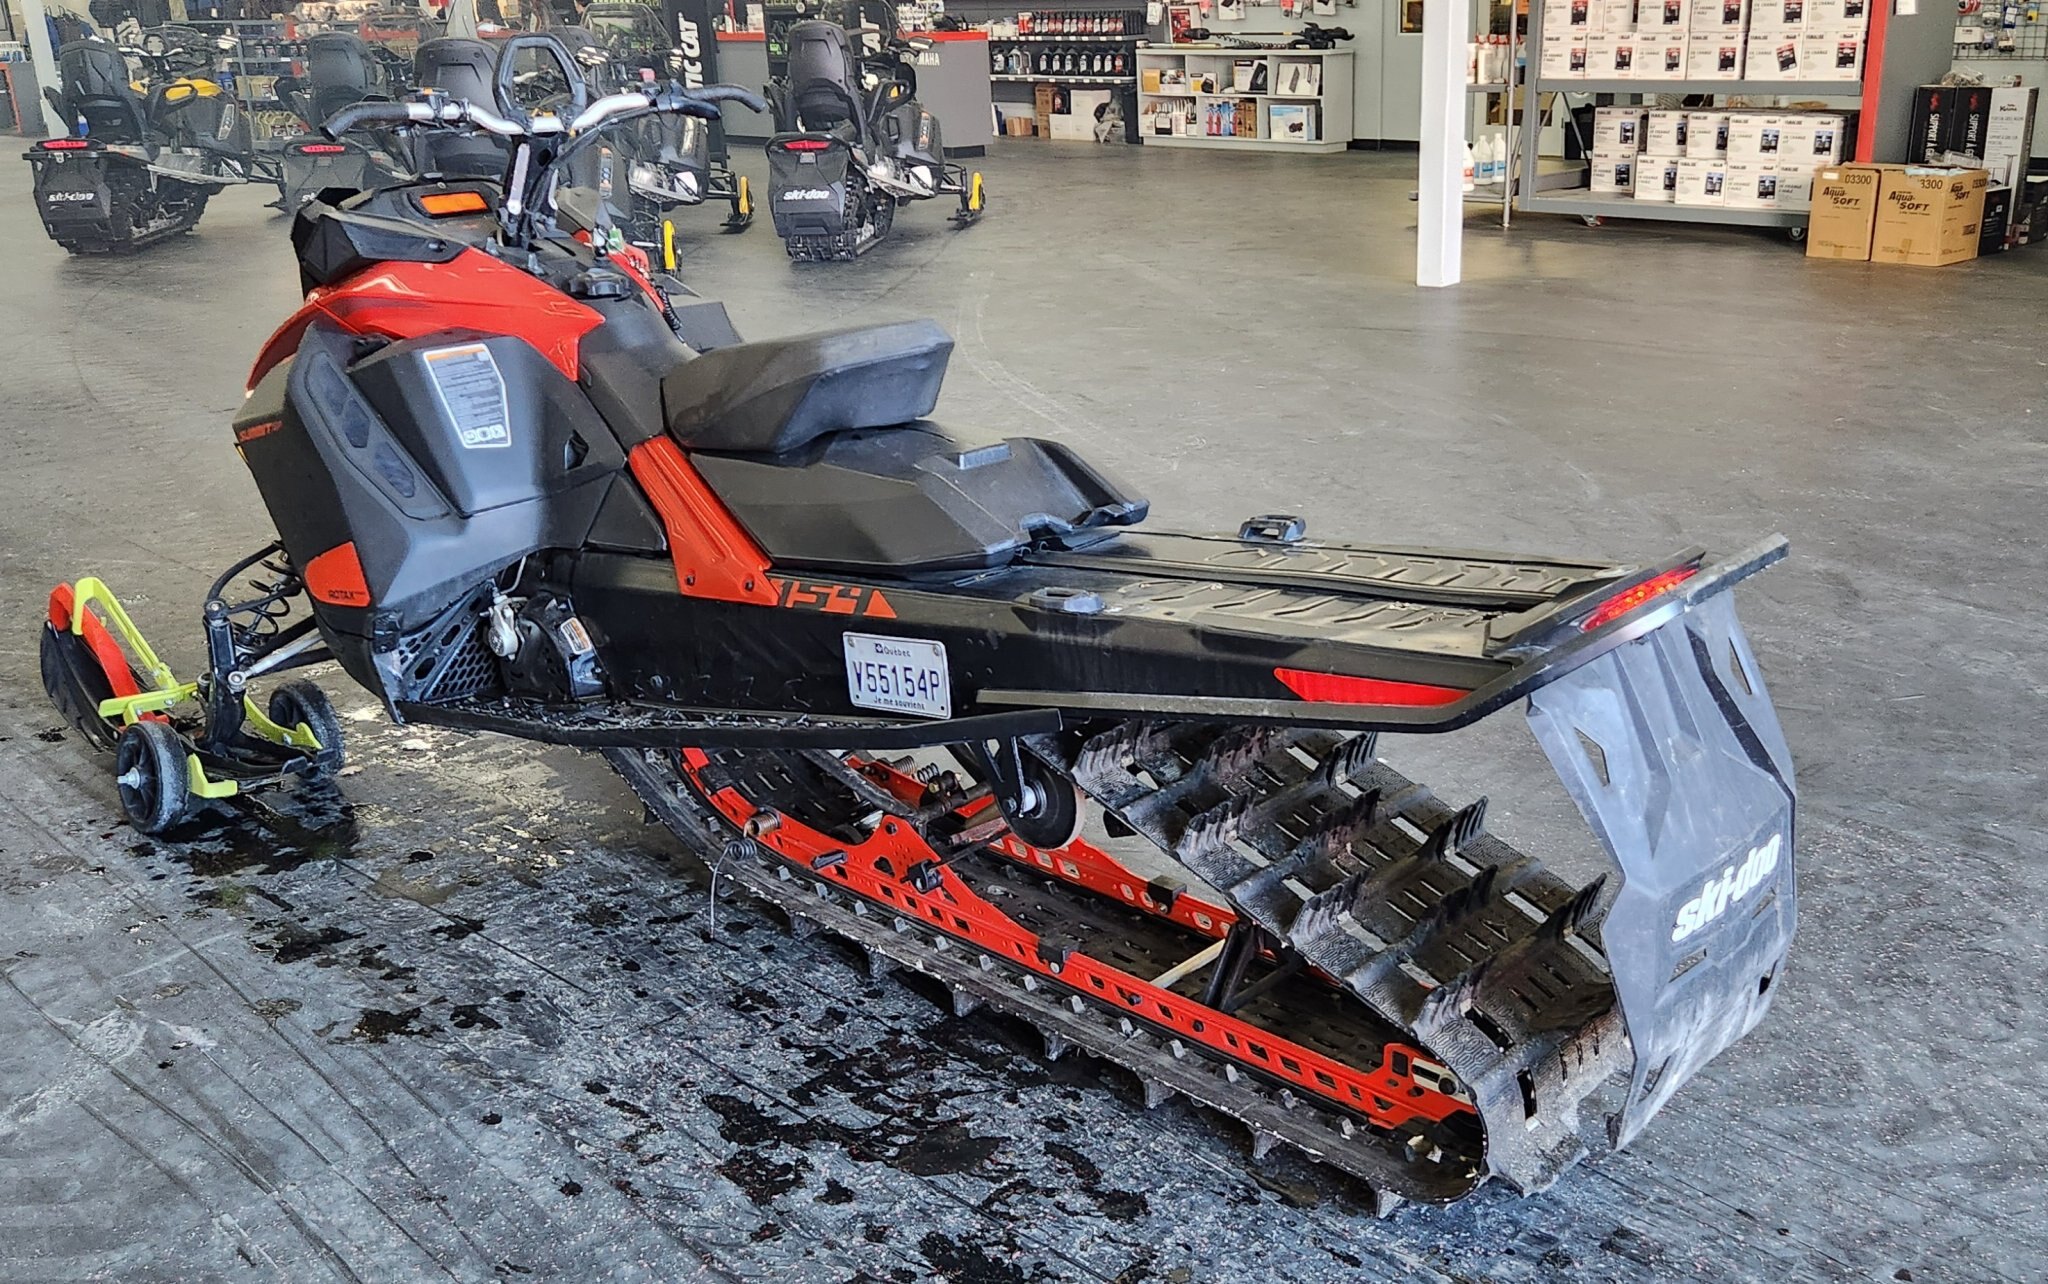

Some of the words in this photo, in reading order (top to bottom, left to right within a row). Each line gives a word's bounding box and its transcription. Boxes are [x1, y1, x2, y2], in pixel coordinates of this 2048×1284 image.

[678, 12, 700, 58] CAT
[1927, 113, 1940, 141] SUPPORT
[1966, 113, 1979, 141] SUPPORT
[1845, 174, 1872, 185] 03300
[1919, 179, 1943, 190] 3300
[783, 189, 830, 201] ski-doo
[1832, 197, 1861, 206] SOFT
[1899, 202, 1930, 212] SOFT
[852, 660, 940, 702] V55154P
[895, 699, 926, 711] souviens
[1671, 833, 1781, 943] ski-doo
